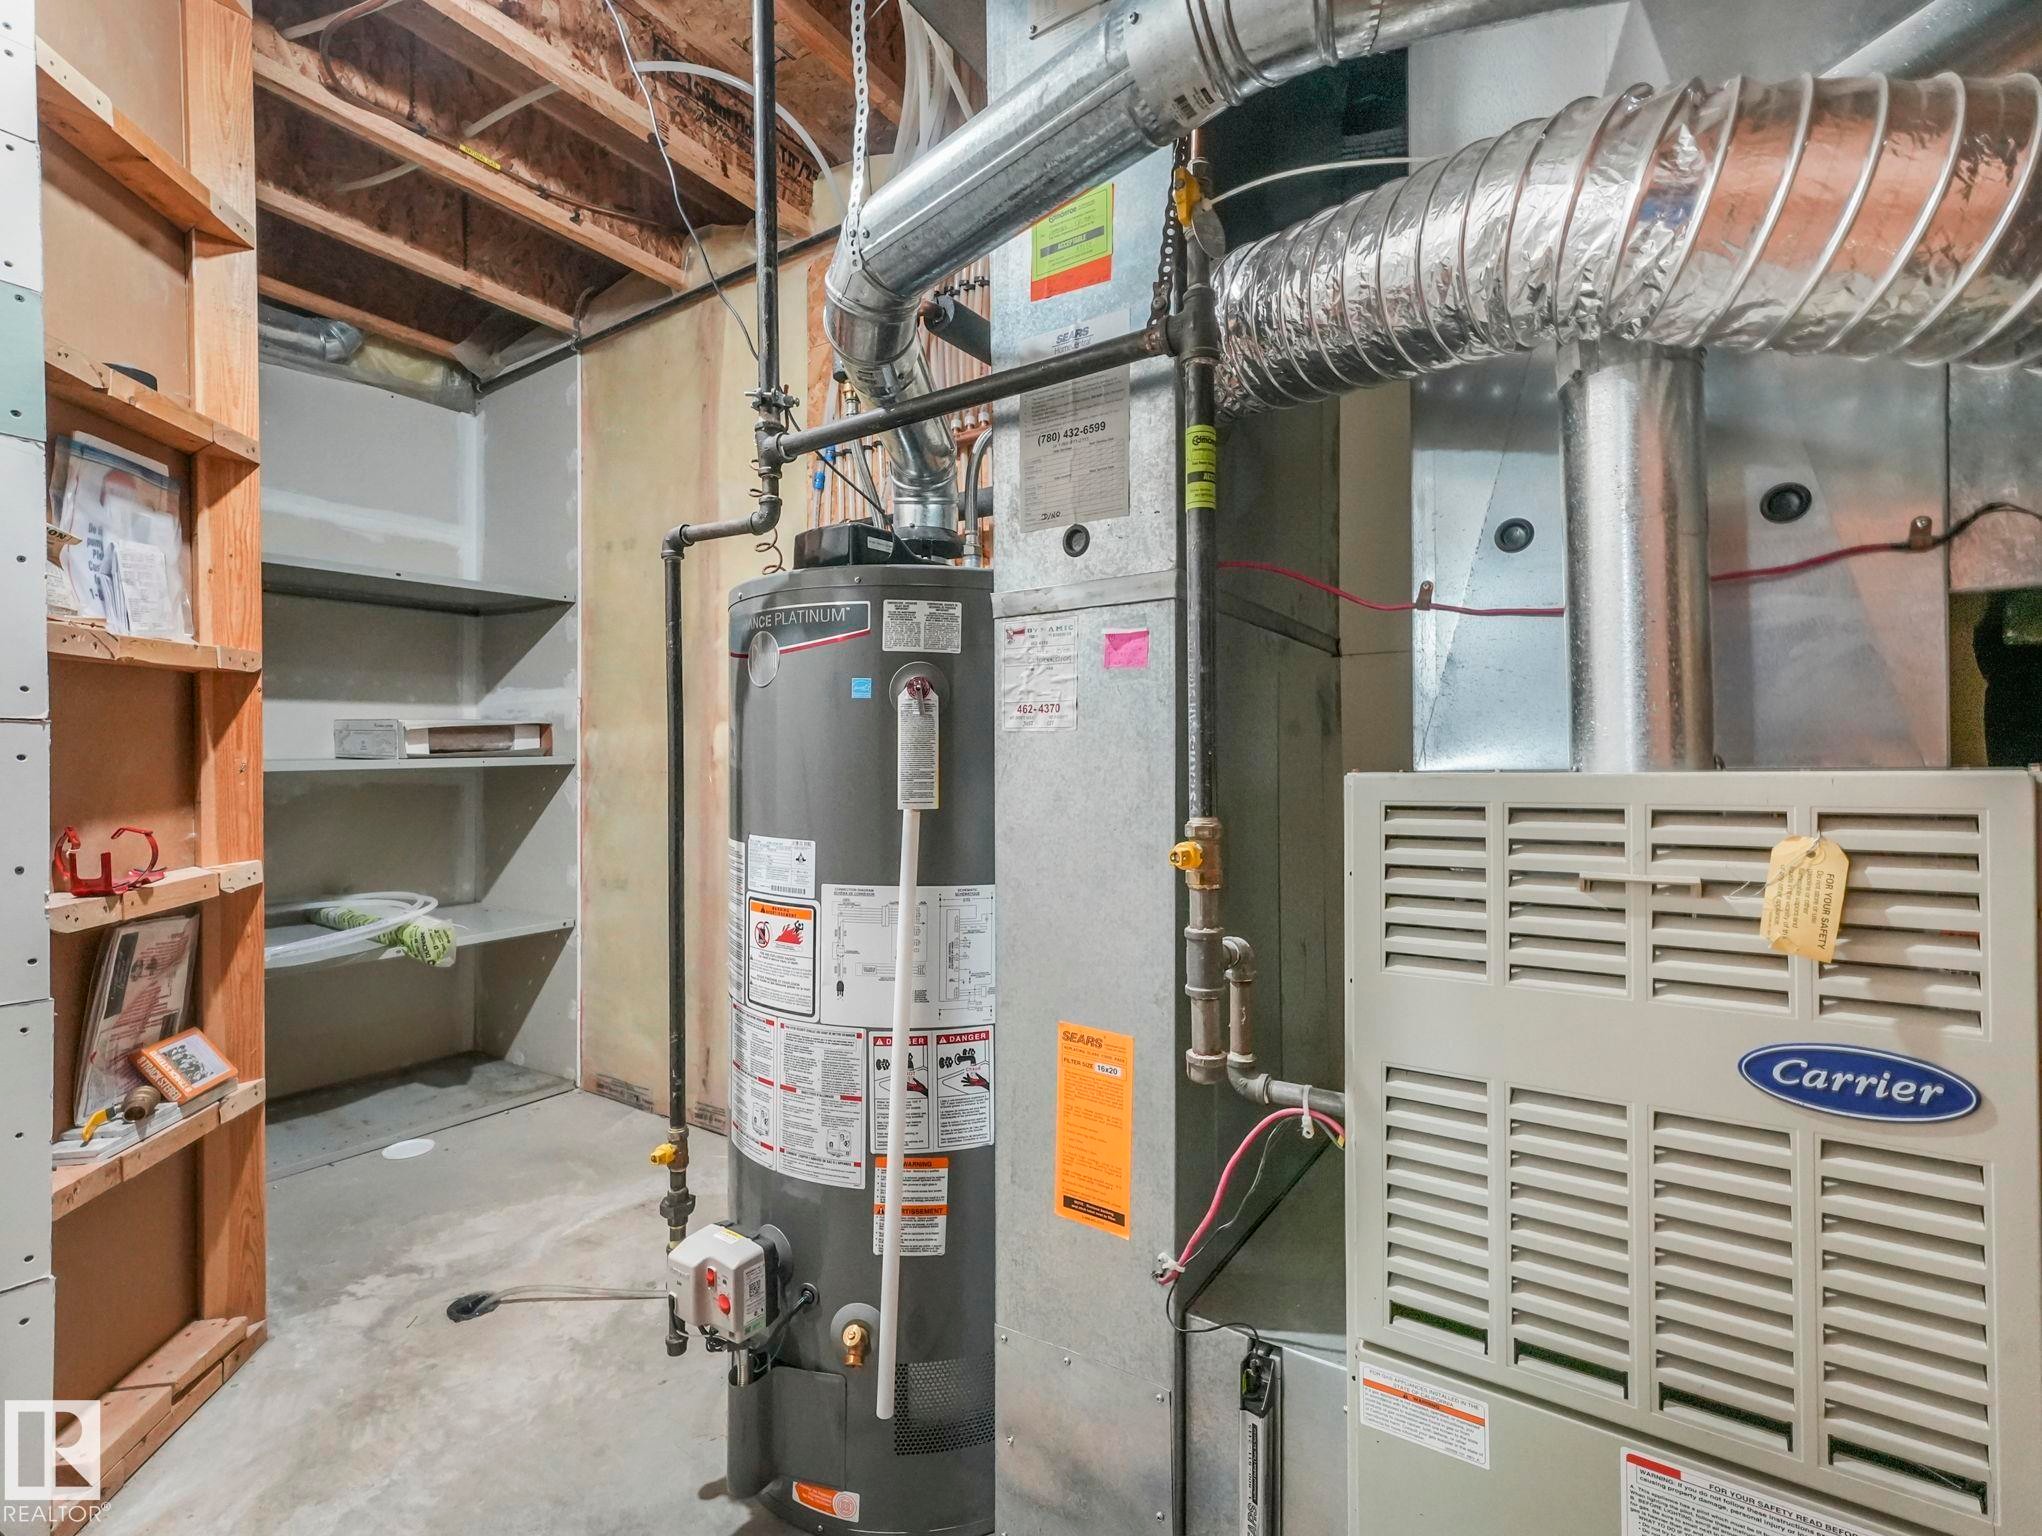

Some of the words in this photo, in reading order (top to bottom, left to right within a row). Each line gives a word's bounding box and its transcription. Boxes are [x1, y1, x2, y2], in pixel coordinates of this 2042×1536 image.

[1056, 326, 1090, 344] SEARS
[1038, 431, 1060, 447] (780)
[1063, 421, 1106, 440] 432-6599
[47, 527, 66, 540] ON
[1017, 704, 1060, 714] 462-4370
[1825, 873, 1835, 890] FOR
[1822, 892, 1832, 915] YOUR
[1817, 917, 1829, 950] SAFETY
[949, 1034, 986, 1044] DANGER
[1062, 1030, 1103, 1048] SEARS
[1098, 1065, 1118, 1074] 16x20
[1772, 1059, 1944, 1106] Carrier
[1640, 1476, 1665, 1490] causing
[1668, 1486, 1696, 1501] property
[1699, 1496, 1728, 1512] damage,
[1730, 1508, 1762, 1524] personal
[1764, 1520, 1785, 1532] injury
[1685, 1486, 1697, 1494] you
[1710, 1494, 1721, 1502] not
[1723, 1498, 1745, 1510] follow
[1747, 1507, 1767, 1518] these
[1769, 1515, 1814, 1535] instructions
[1709, 1484, 1727, 1495] FOR
[1730, 1491, 1755, 1505] YOUR
[1758, 1500, 1793, 1519] SAFETY
[1796, 1513, 1822, 1529] READ
